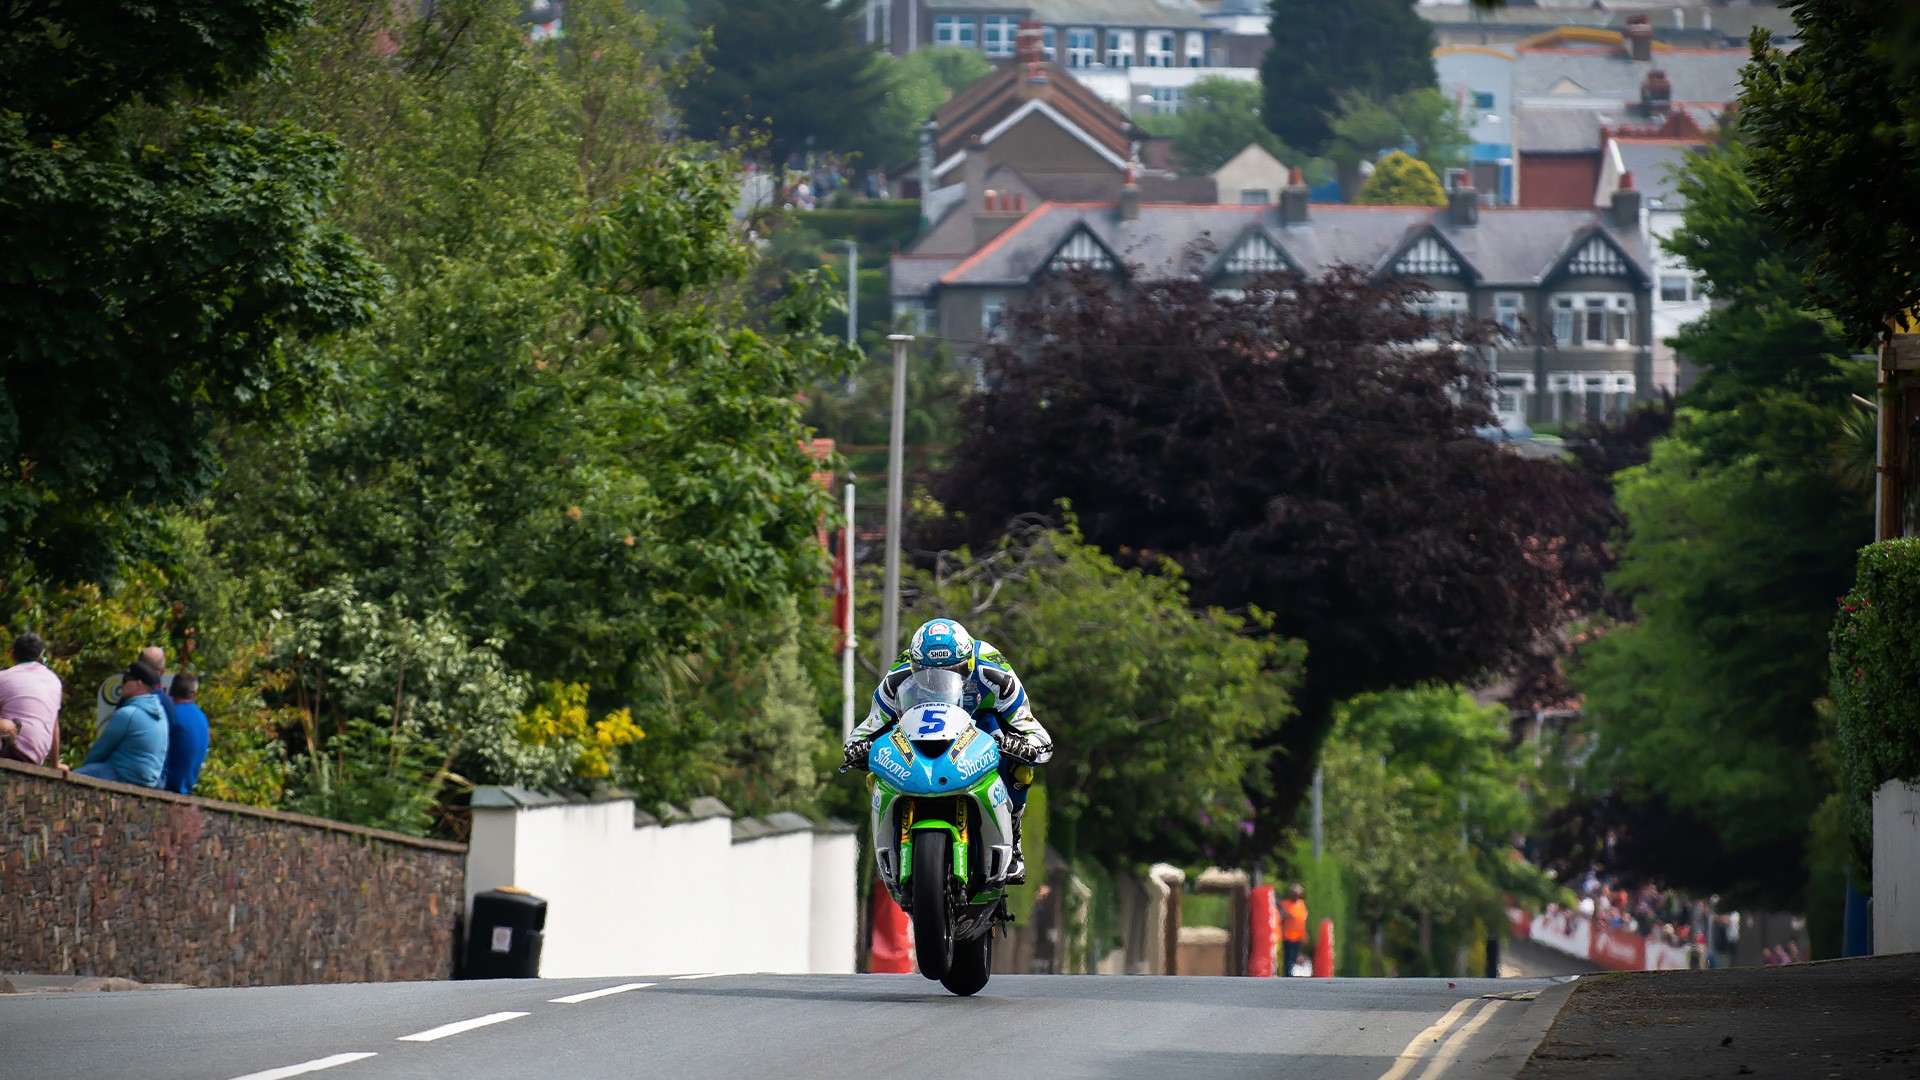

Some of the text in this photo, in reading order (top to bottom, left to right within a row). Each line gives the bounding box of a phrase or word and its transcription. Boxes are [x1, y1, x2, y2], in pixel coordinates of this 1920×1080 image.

[919, 710, 947, 734] 5
[874, 747, 911, 780] Silicone
[957, 749, 997, 780] Silicone
